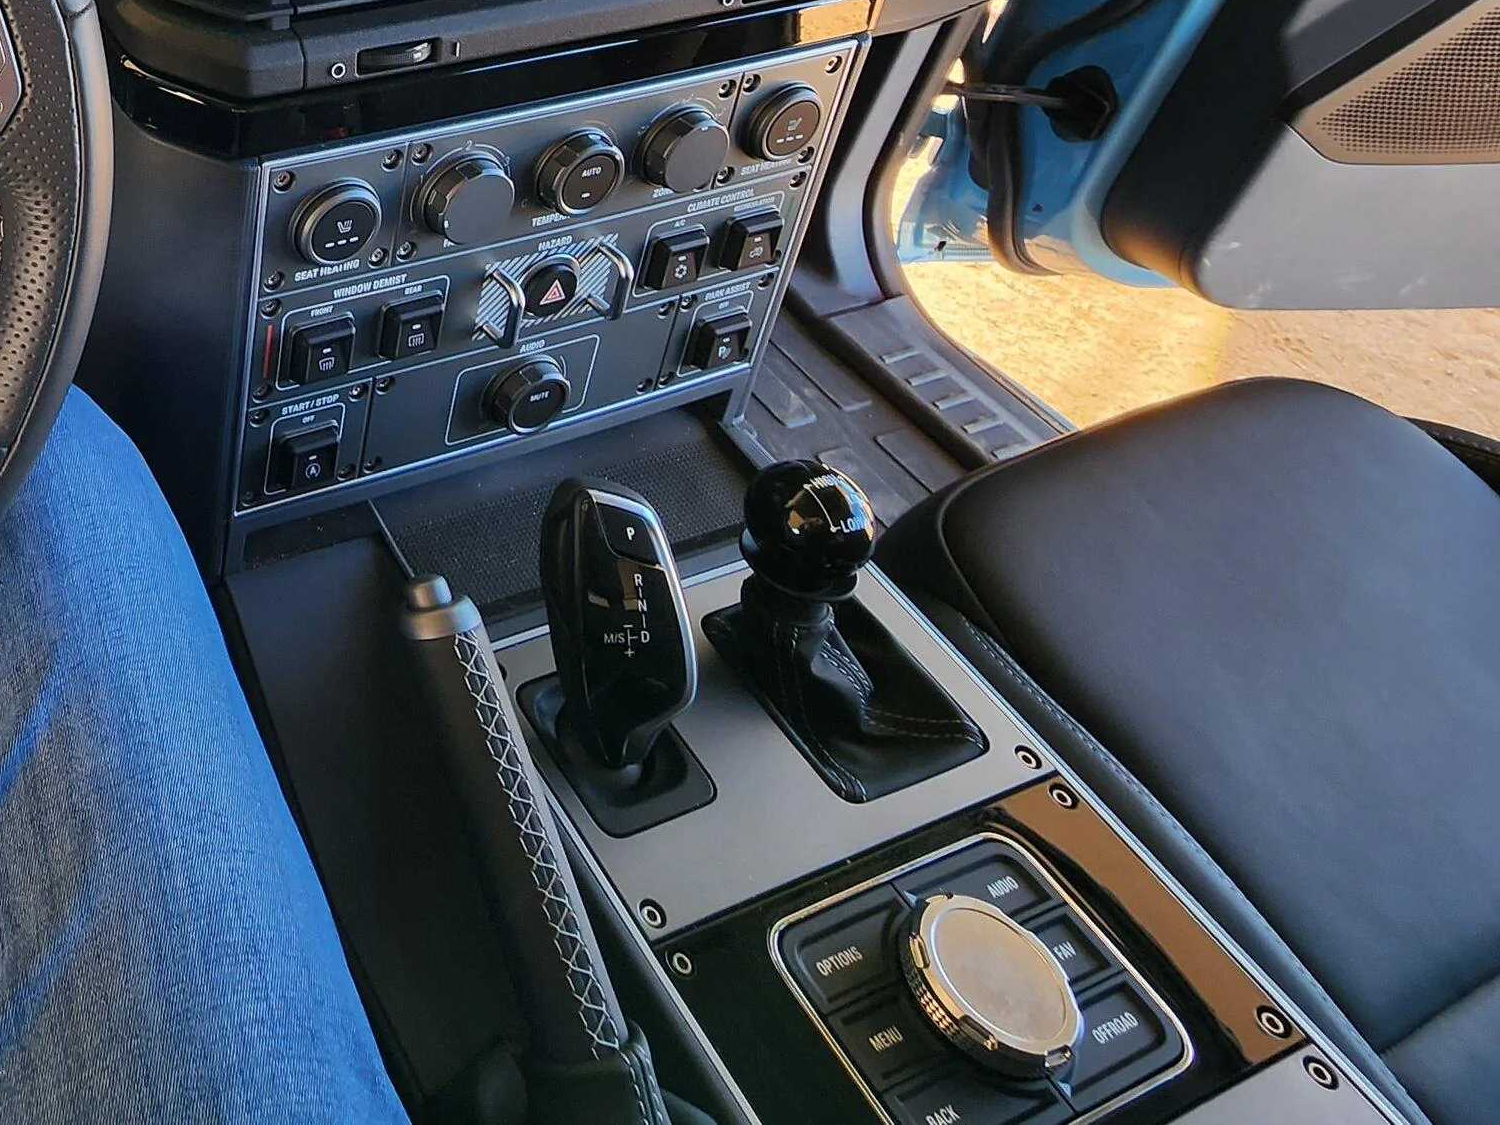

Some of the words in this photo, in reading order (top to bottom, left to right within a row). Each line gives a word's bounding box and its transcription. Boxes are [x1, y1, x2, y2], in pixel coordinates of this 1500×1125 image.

[465, 140, 473, 151] 2
[581, 166, 601, 178] AUTO
[740, 163, 760, 177] SEAT
[687, 196, 720, 213] CLIMATE
[721, 188, 755, 204] CONTROL
[674, 219, 686, 227] A/C
[539, 235, 573, 251] HAZARD
[295, 268, 319, 281] SEAT
[333, 282, 372, 299] WINDOW
[372, 274, 407, 291] DEMIST
[404, 285, 422, 296] REAR
[705, 288, 724, 301] PARK
[724, 281, 751, 296] ASSIST
[311, 305, 334, 317] FRONT
[519, 339, 546, 354] AUDIO
[530, 391, 550, 402] MUTE
[302, 415, 315, 424] OFF
[626, 526, 635, 541] P
[634, 573, 643, 587] R
[638, 599, 648, 612] N
[603, 632, 625, 644] M/S
[641, 631, 650, 643] D
[986, 875, 1019, 899] AUDIO
[1053, 941, 1077, 961] FAV
[816, 945, 863, 976] OPTIONS
[1092, 1011, 1139, 1045] OFFROAD
[868, 1025, 904, 1053] MENU
